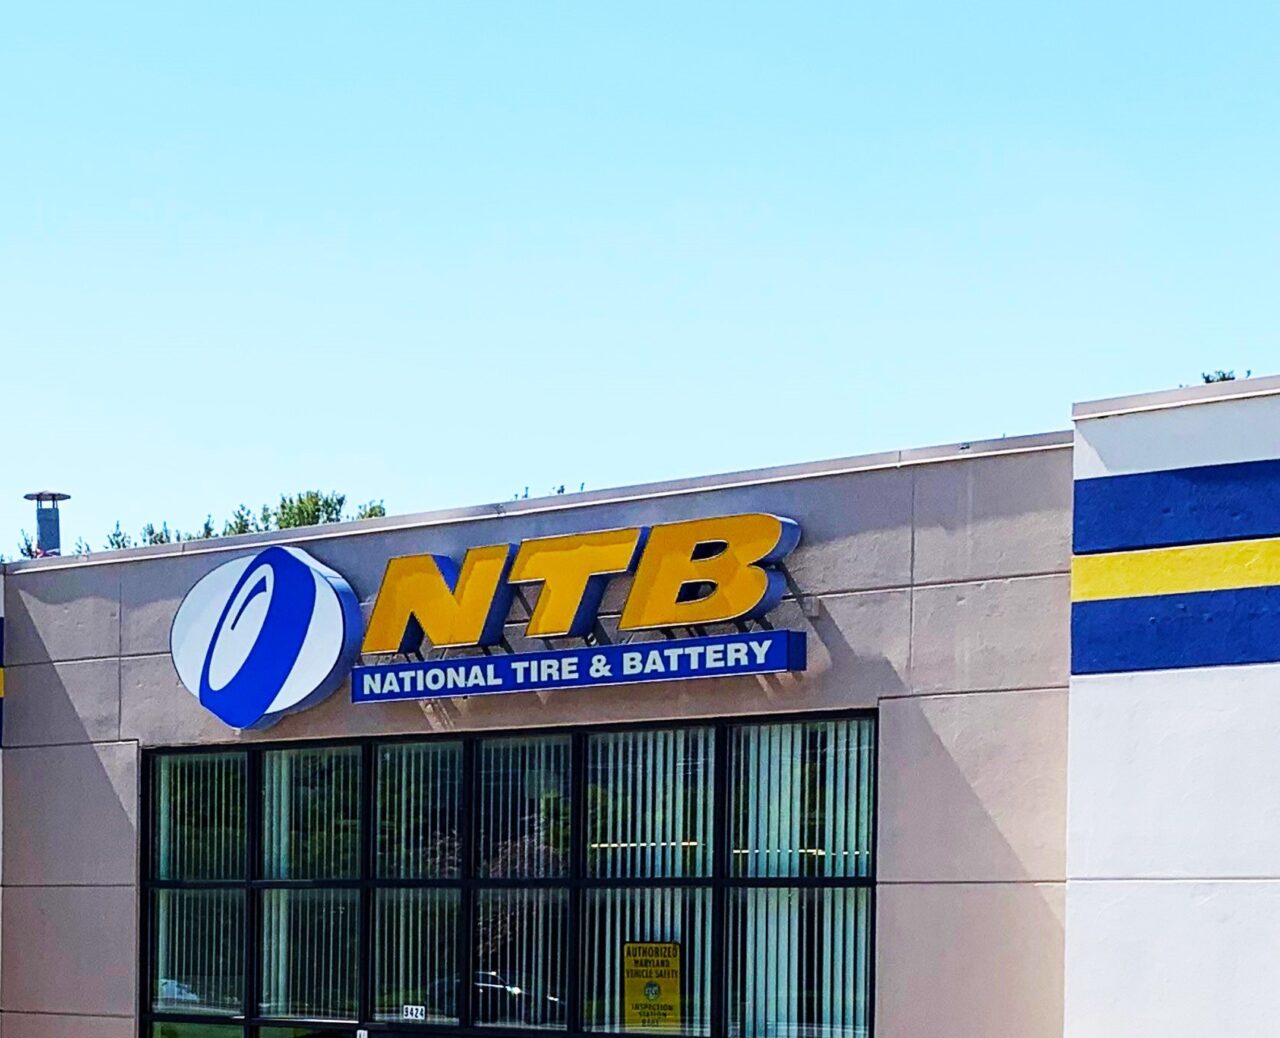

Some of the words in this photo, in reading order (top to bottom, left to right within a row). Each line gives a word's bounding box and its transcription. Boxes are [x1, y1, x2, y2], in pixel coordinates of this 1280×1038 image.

[361, 512, 788, 654] NTB
[362, 666, 503, 695] NATIONAL
[510, 655, 579, 684] TIRE
[589, 654, 612, 678] &
[622, 640, 773, 677] BATTERY
[626, 946, 678, 958] AUTHORIZED
[633, 959, 670, 968] MARYLAND
[626, 969, 653, 978] VEHICLE
[655, 969, 678, 979] SAFETY
